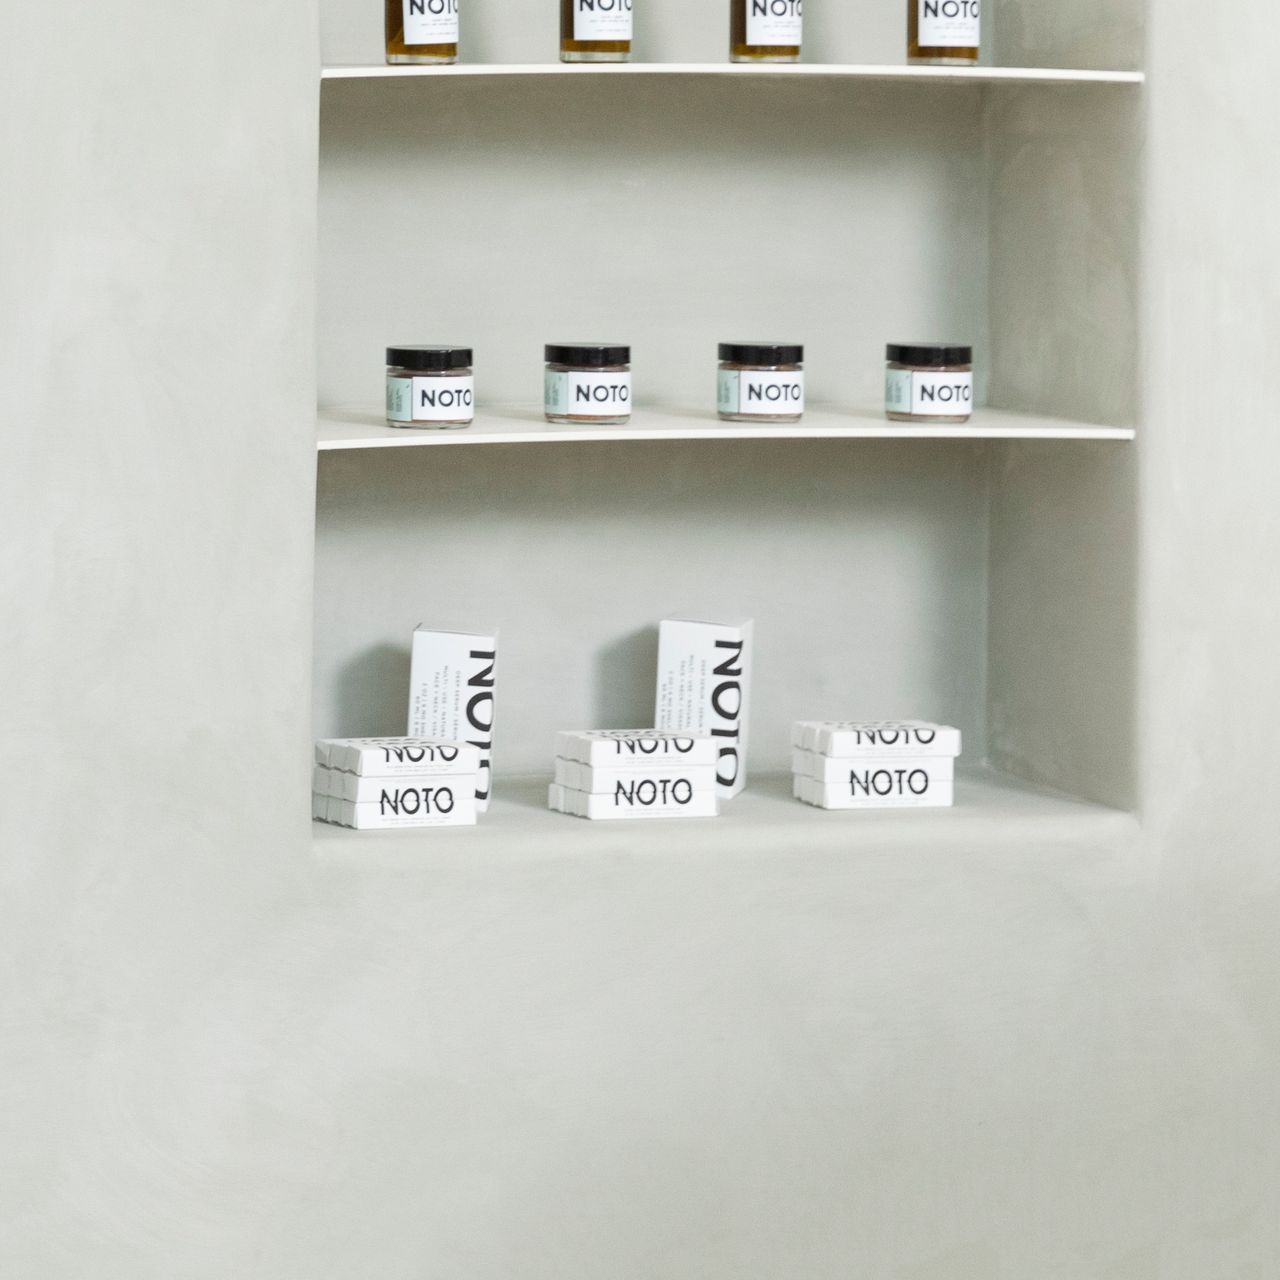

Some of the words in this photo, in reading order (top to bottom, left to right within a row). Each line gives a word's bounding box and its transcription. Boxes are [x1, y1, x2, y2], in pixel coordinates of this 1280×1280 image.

[421, 389, 471, 407] NOTO
[576, 384, 628, 402] NOTO
[748, 384, 800, 401] NOTO
[615, 778, 692, 806] NOTO
[849, 769, 929, 796] NOTO
[380, 787, 454, 816] NOTO
